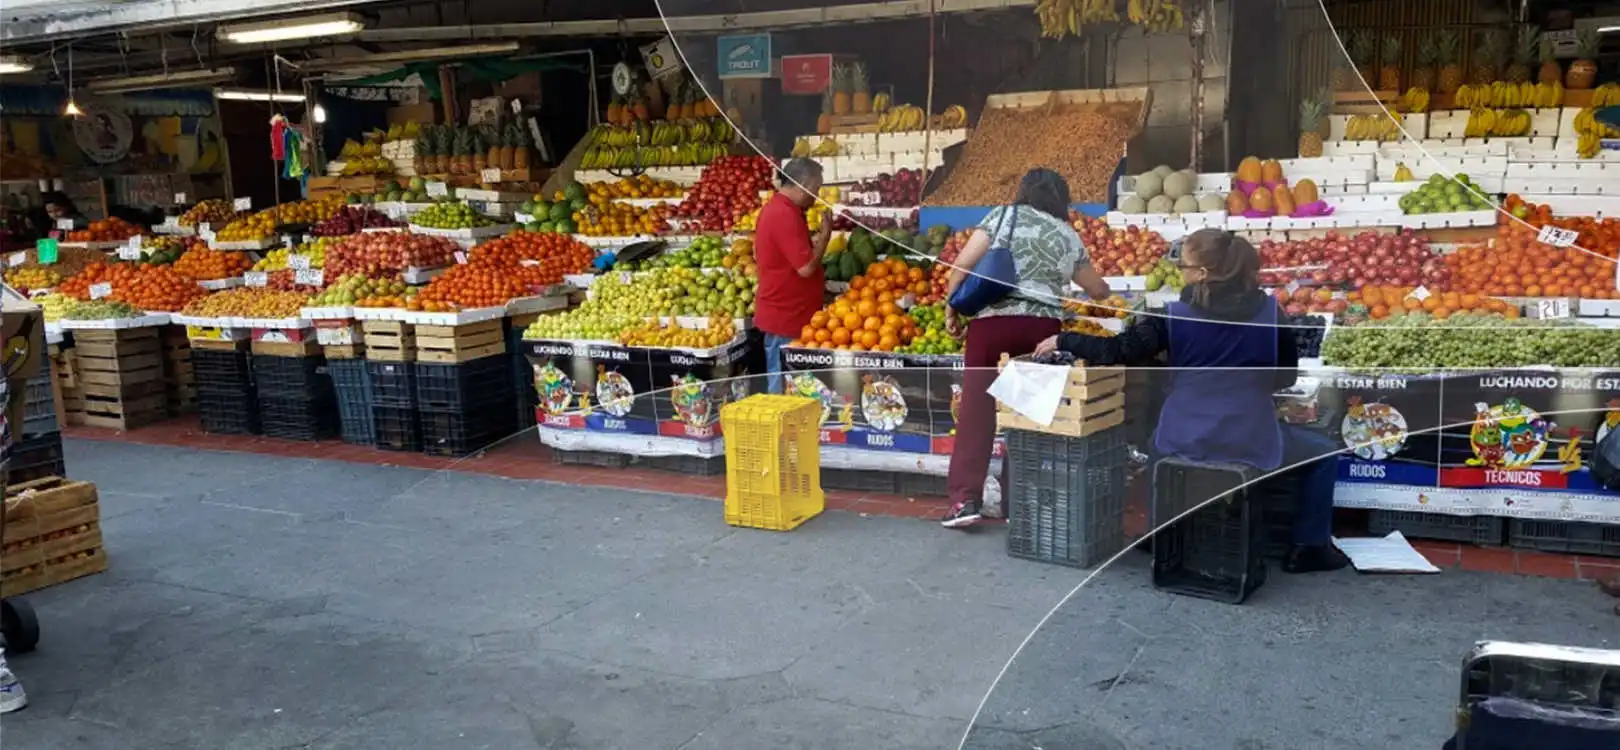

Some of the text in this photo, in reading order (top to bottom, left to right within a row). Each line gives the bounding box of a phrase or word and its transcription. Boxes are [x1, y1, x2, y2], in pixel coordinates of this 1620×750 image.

[785, 353, 832, 365] LUCHANDO
[855, 357, 881, 367] ESTAR
[882, 358, 904, 368] BIEN
[1337, 378, 1374, 389] ESTAR
[1377, 378, 1407, 389] BIEN
[1479, 377, 1558, 389] LUCHANDO
[1561, 378, 1593, 390] POR
[866, 433, 894, 447] RUDOS
[1349, 463, 1387, 479] RUDOS
